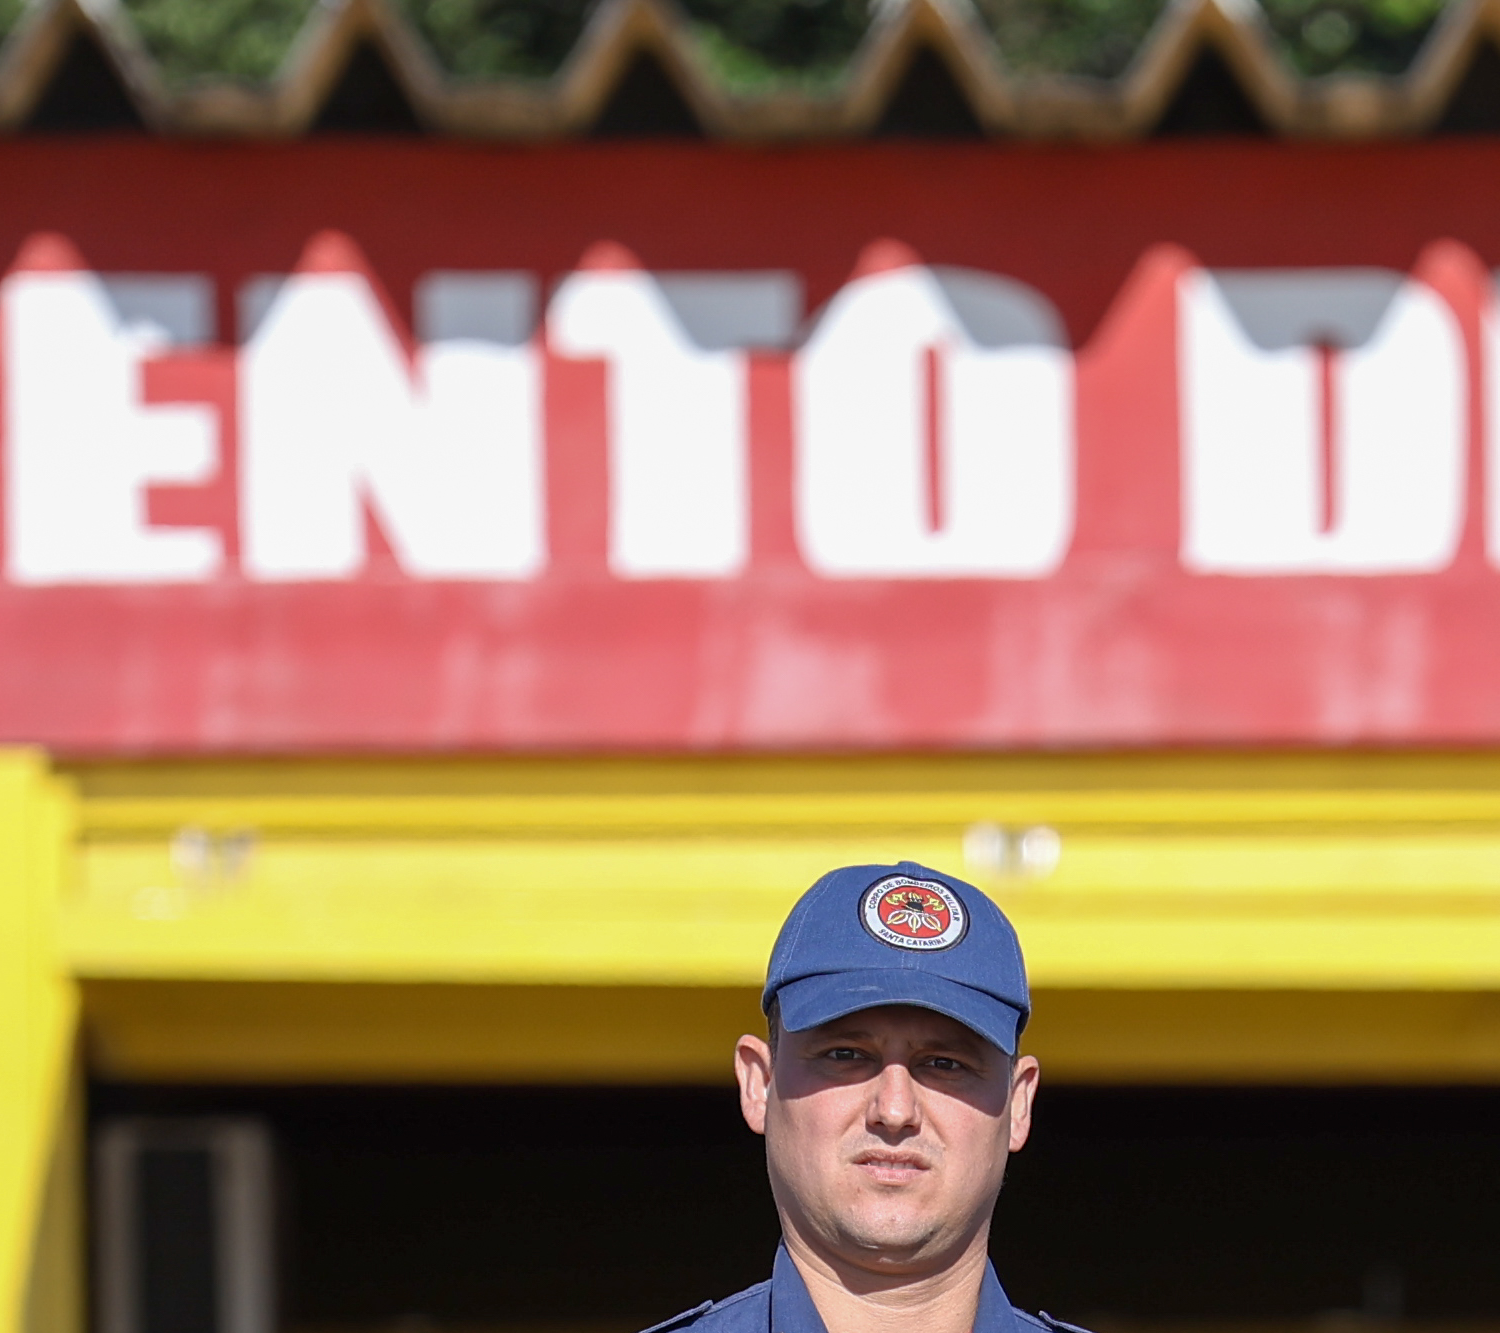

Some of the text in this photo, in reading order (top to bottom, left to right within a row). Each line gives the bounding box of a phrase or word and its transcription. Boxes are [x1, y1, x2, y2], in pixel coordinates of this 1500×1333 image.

[868, 888, 886, 910] CORPO
[882, 881, 895, 891] DE
[878, 928, 948, 947] SANTA CATARINA
